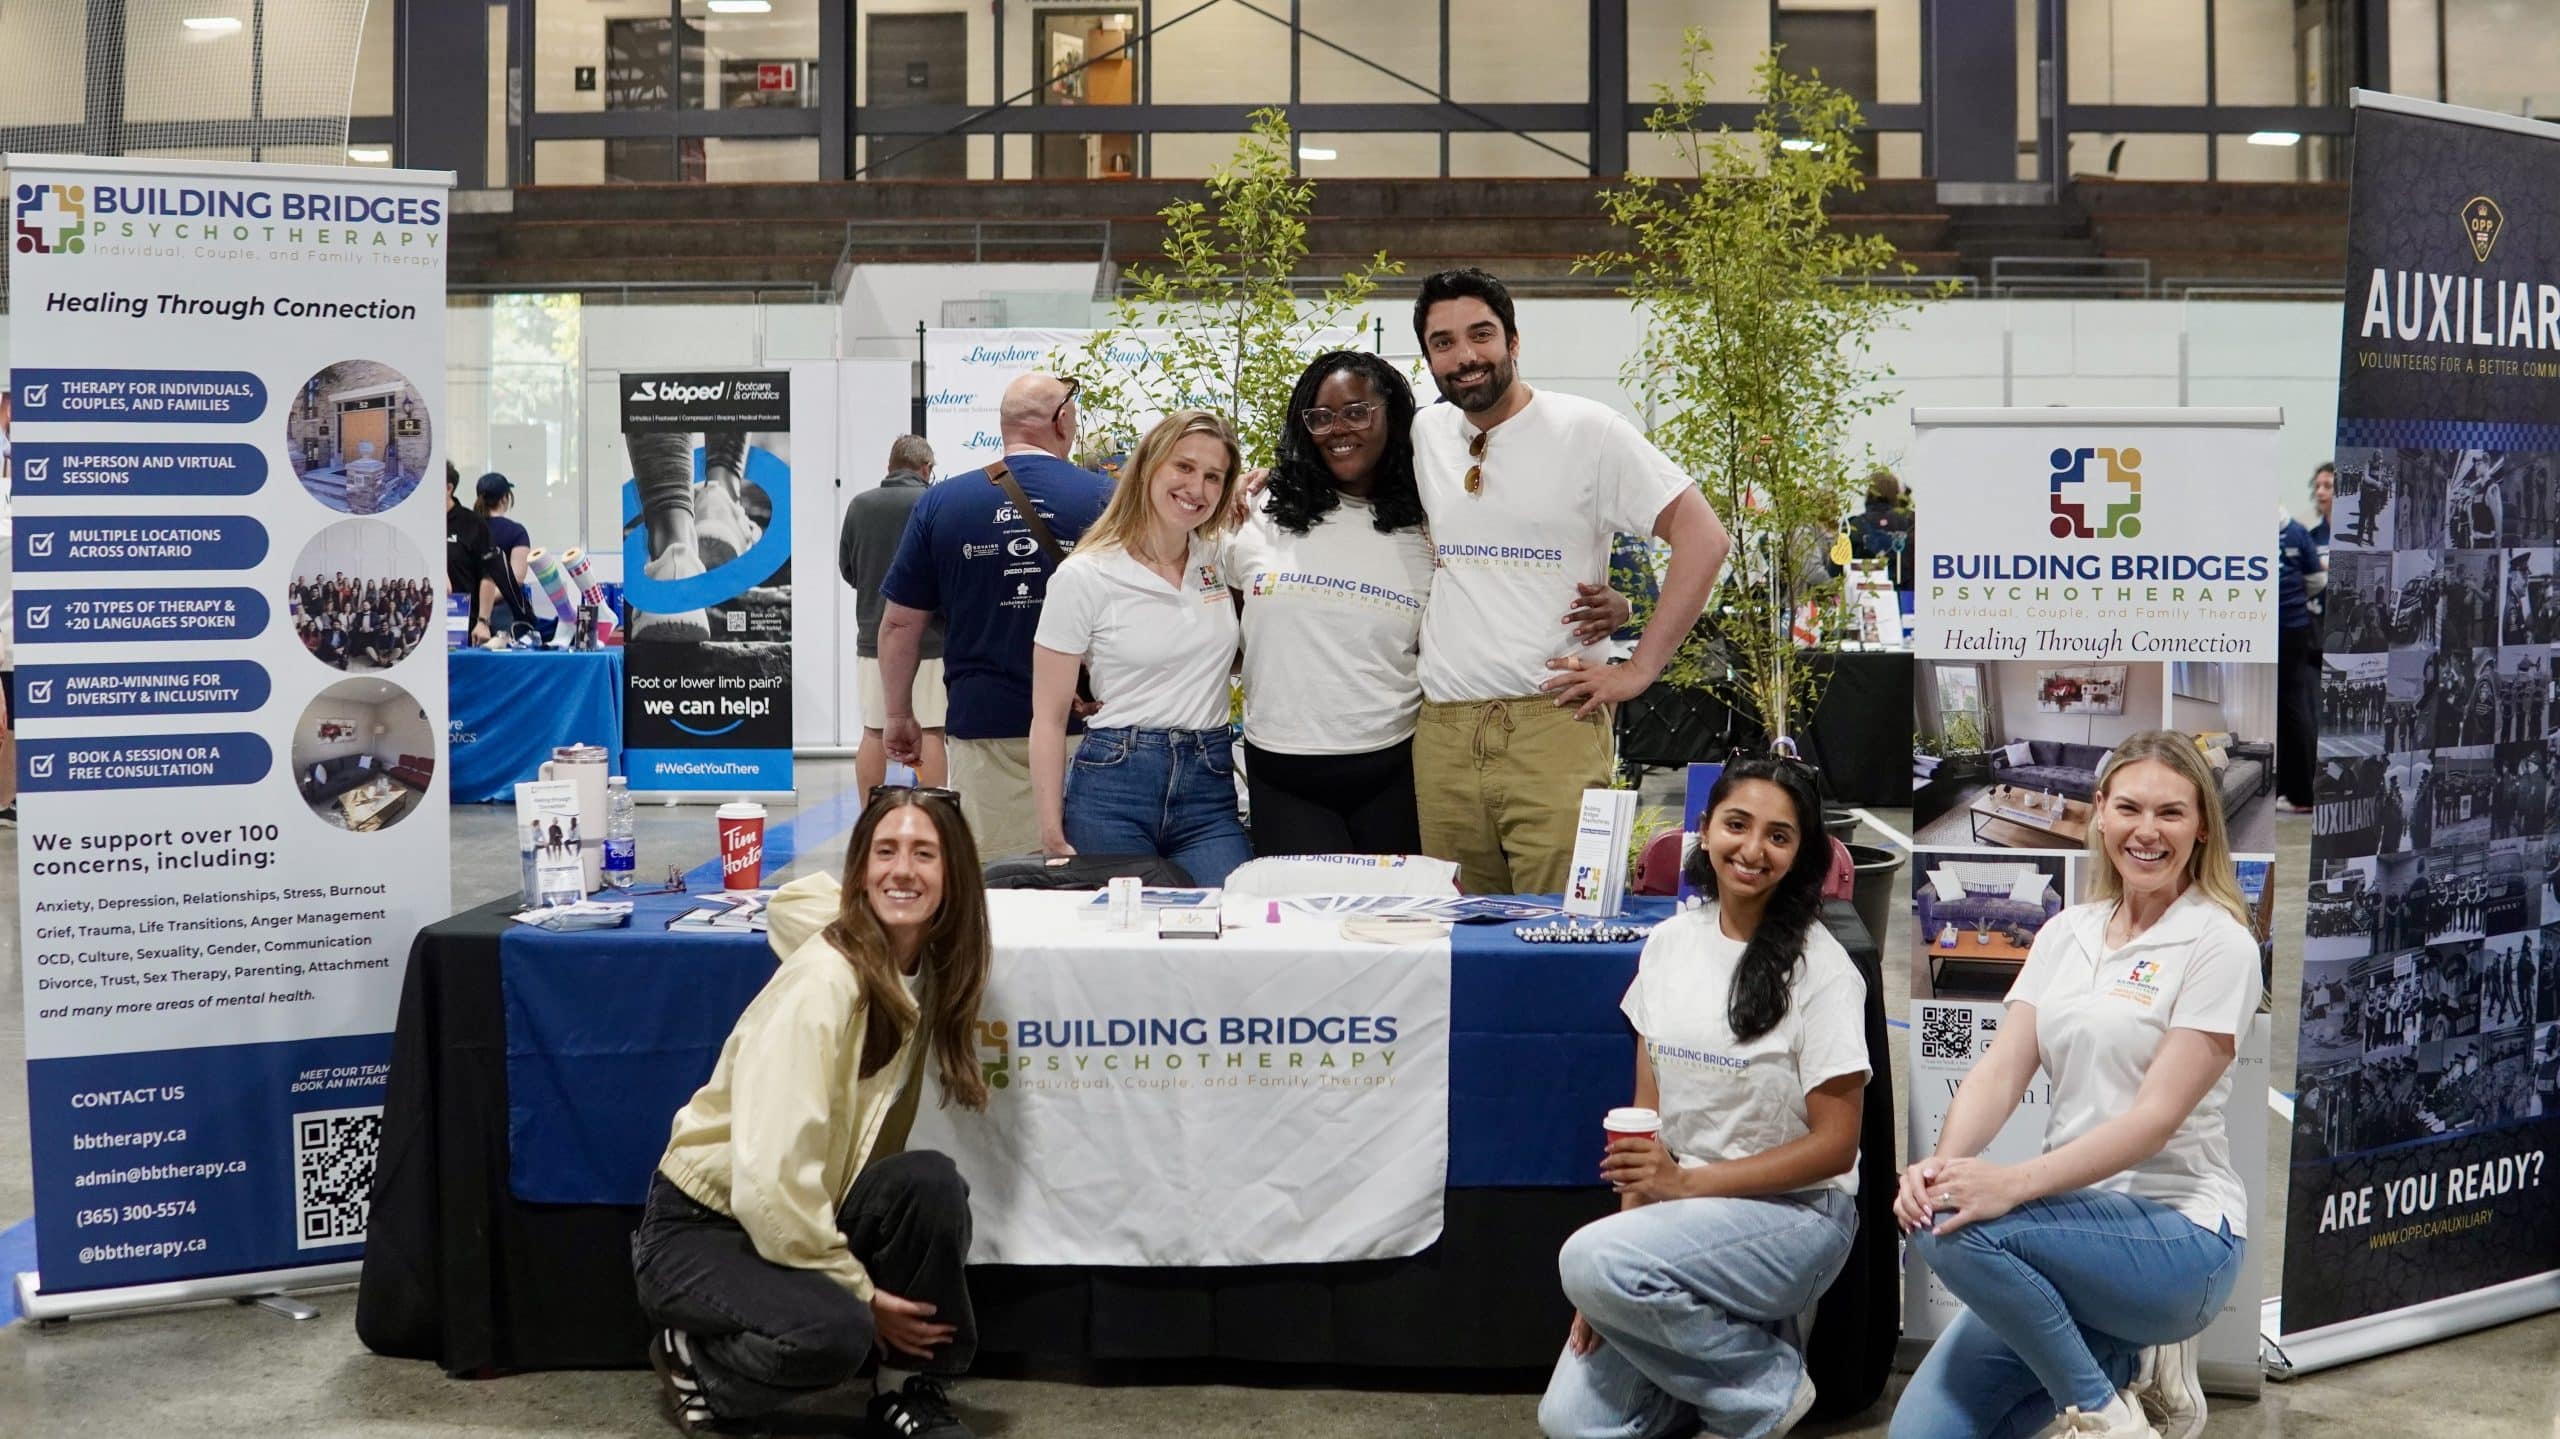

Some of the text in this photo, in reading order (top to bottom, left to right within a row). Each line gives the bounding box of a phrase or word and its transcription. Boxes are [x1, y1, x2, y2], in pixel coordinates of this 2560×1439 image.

[94, 186, 440, 226] BUILDING BRIDGES
[94, 221, 438, 248] PSYCHOTHERAPY
[94, 243, 184, 259] Individual,
[269, 249, 299, 261] and
[308, 250, 362, 264] Family
[372, 252, 439, 268] Therapy
[47, 291, 415, 320] Healing Through Connection
[960, 344, 1039, 367] Bayshore
[2359, 351, 2560, 379] VOLUNTEERS FOR A BETTER COMM
[62, 382, 253, 397] THERAPY FOR INDIVIDUALS,
[659, 381, 725, 405] bioped
[736, 380, 772, 392] footcare
[62, 397, 230, 411] COUPLES, AND FAMILIES
[63, 456, 236, 468] IN-PERSON AND VIRTUAL
[63, 472, 129, 484] SESSIONS
[70, 529, 221, 542] MULTIPLE LOCATIONS
[69, 545, 192, 558] ACROSS ONTARIO
[1440, 544, 1562, 561] BUILDING BRIDGES
[1933, 555, 2268, 581] BUILDING BRIDGES
[1279, 572, 1421, 609] BUILDING BRIDGES
[1933, 586, 2266, 602] PSYCHOTHERAPY
[65, 600, 235, 614] +70 TYPES OF THERAPY &
[2098, 608, 2127, 618] and
[2136, 607, 2189, 621] Family
[2199, 607, 2267, 623] Therapy
[65, 615, 235, 630] +20 LANGUAGES SPOKEN
[1944, 627, 2250, 659] Healing Through Connection
[66, 674, 220, 690] AWARD-WINNING FOR
[631, 676, 783, 690] Foot or lower limb pain?
[67, 689, 239, 705] DIVERSITY & INCLUSIVITY
[644, 696, 769, 718] we can help!
[69, 747, 220, 764] BOOK A SESSION OR A
[69, 763, 213, 779] FREE CONSULTATION
[655, 763, 759, 774] #WeGetYouThere
[33, 824, 278, 852] We support over 100
[723, 825, 757, 852] Tim
[33, 848, 275, 875] concerns, including:
[36, 884, 386, 913] Anxiety, Depression, Relationships, Stress, Burnout
[37, 909, 385, 939] Grief, Trauma, Life Transitions, Anger Management
[38, 935, 372, 965] OCD, Culture, Sexuality, Gender, Communication
[39, 958, 389, 990] Divorce, Trust, Sex Therapy, Parenting, Attachment
[40, 989, 315, 1018] and many more areas of mental health.
[1018, 1016, 1397, 1048] BUILDING BRIDGES
[1018, 1050, 1395, 1072] PSYCHOTHERAPY
[1658, 1044, 1702, 1061] BUILDING
[1703, 1053, 1751, 1069] BRIDGES
[300, 1064, 391, 1080] MEET OUR TEAM
[1204, 1075, 1238, 1087] and
[1317, 1072, 1395, 1088] Therapy
[291, 1075, 387, 1092] BOOK AN INTAKE
[71, 1086, 185, 1108] CONTACT US
[74, 1129, 186, 1150] bbtherapy.ca
[75, 1161, 246, 1187] admin@bbtherapy.ca
[2319, 1150, 2544, 1233] ARE YOU READY?
[77, 1200, 196, 1228] (365) 300-5574
[2369, 1208, 2494, 1250] WWW.OPP.CA/AUXILIARY
[79, 1239, 206, 1264] @bbtherapy.ca
